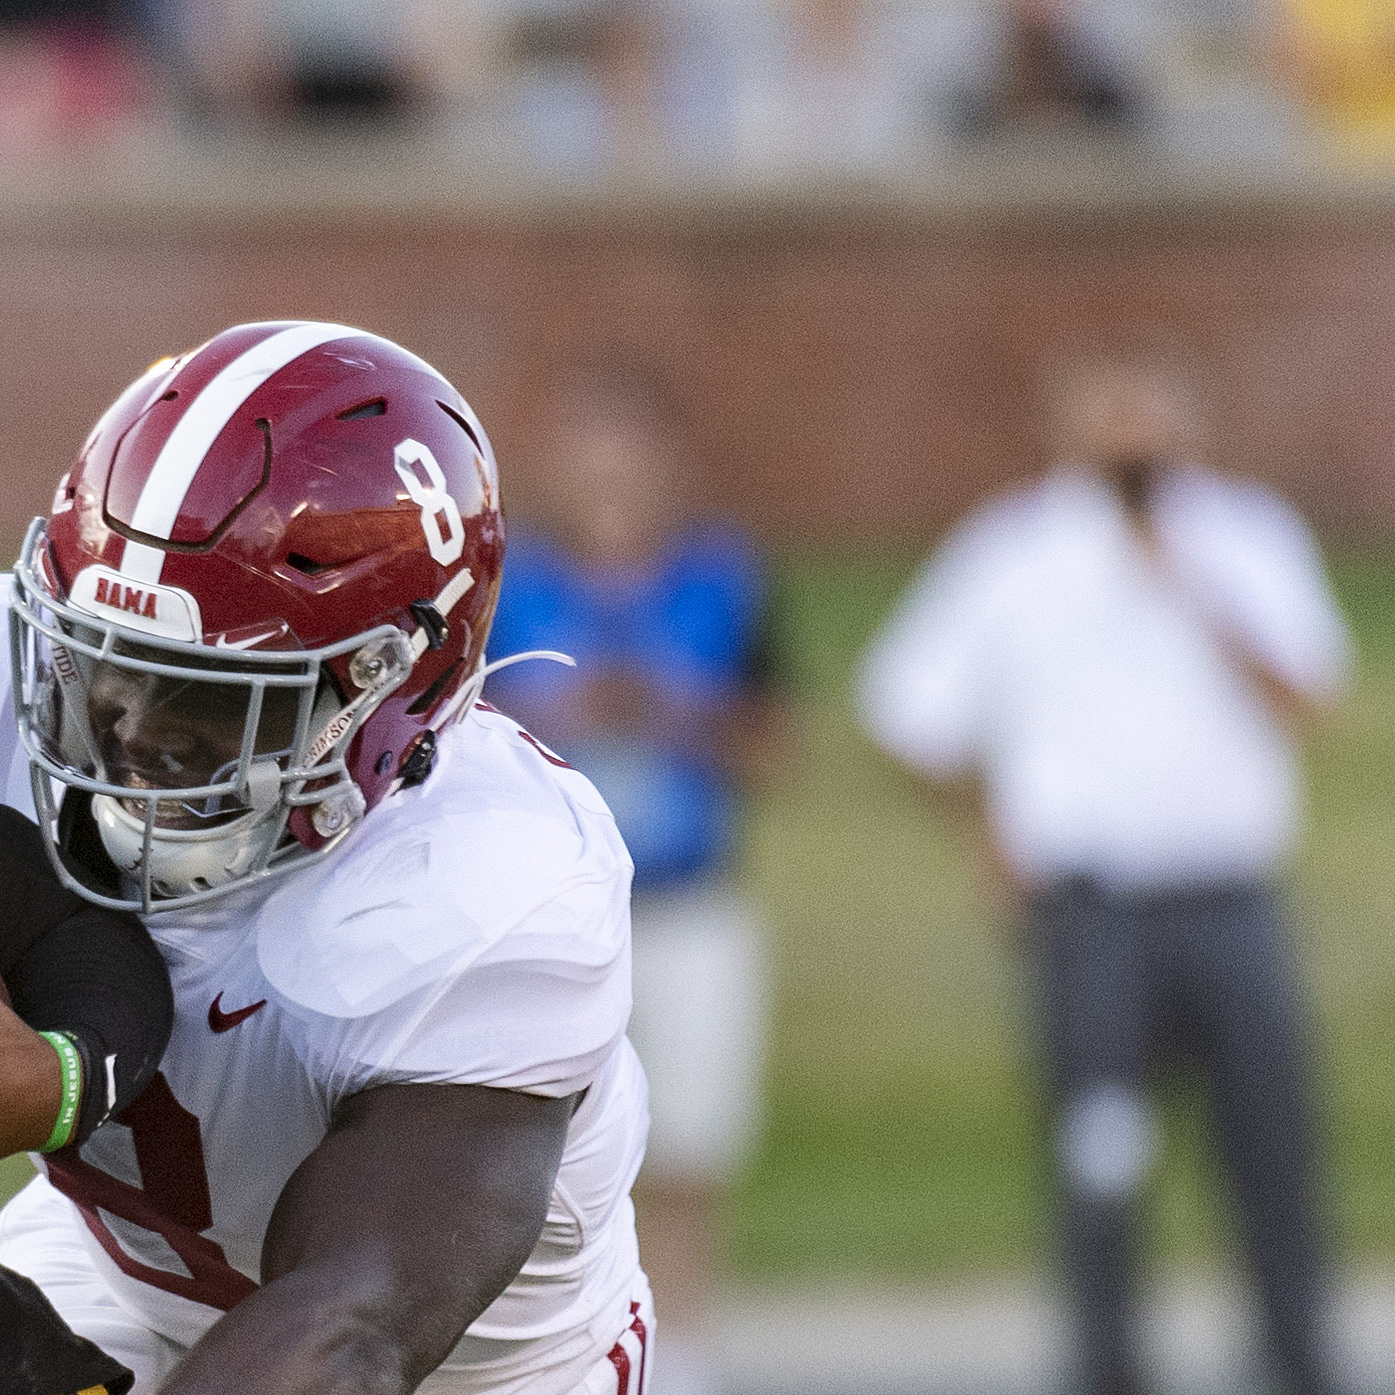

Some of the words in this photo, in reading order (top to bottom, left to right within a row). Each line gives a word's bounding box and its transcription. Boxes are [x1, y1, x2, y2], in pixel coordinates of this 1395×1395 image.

[394, 438, 465, 567] 8
[94, 577, 158, 620] BAMA
[63, 1047, 77, 1103] JESUS
[62, 1107, 74, 1124] IN
